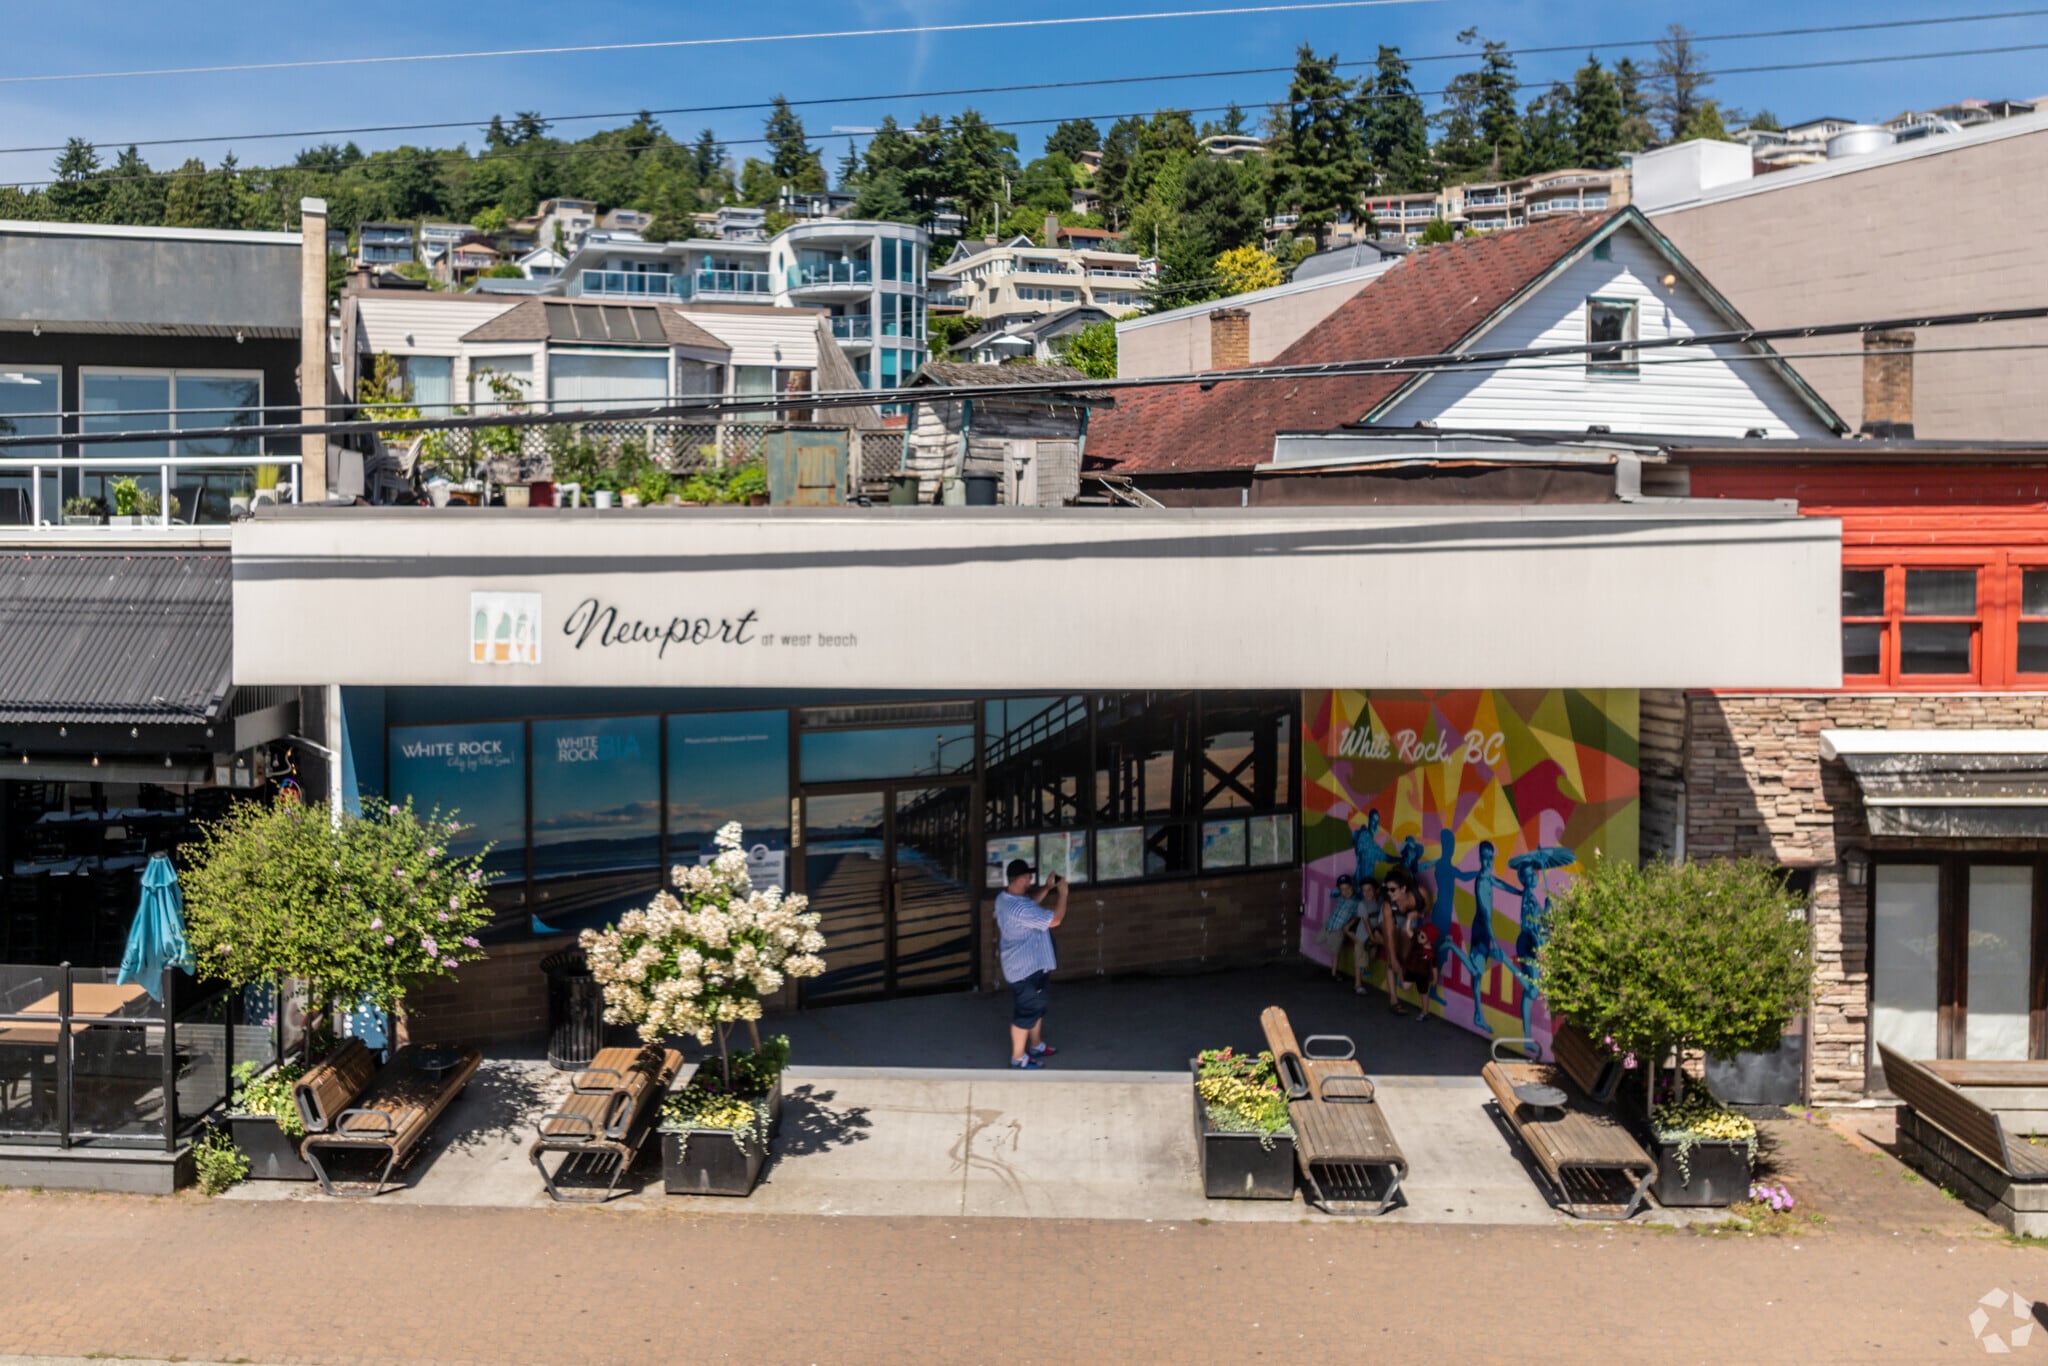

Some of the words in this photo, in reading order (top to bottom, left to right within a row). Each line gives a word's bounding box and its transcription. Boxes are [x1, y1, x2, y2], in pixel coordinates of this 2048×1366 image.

[563, 598, 759, 660] Newport
[761, 633, 774, 647] at
[781, 633, 811, 647] west
[818, 632, 858, 648] beach
[402, 740, 454, 758] WHITE
[459, 740, 502, 756] ROCK
[556, 736, 599, 749] WHITE
[600, 735, 640, 760] BIA
[558, 748, 599, 762] ROCK
[1339, 725, 1391, 760] White
[1464, 729, 1505, 766] BC
